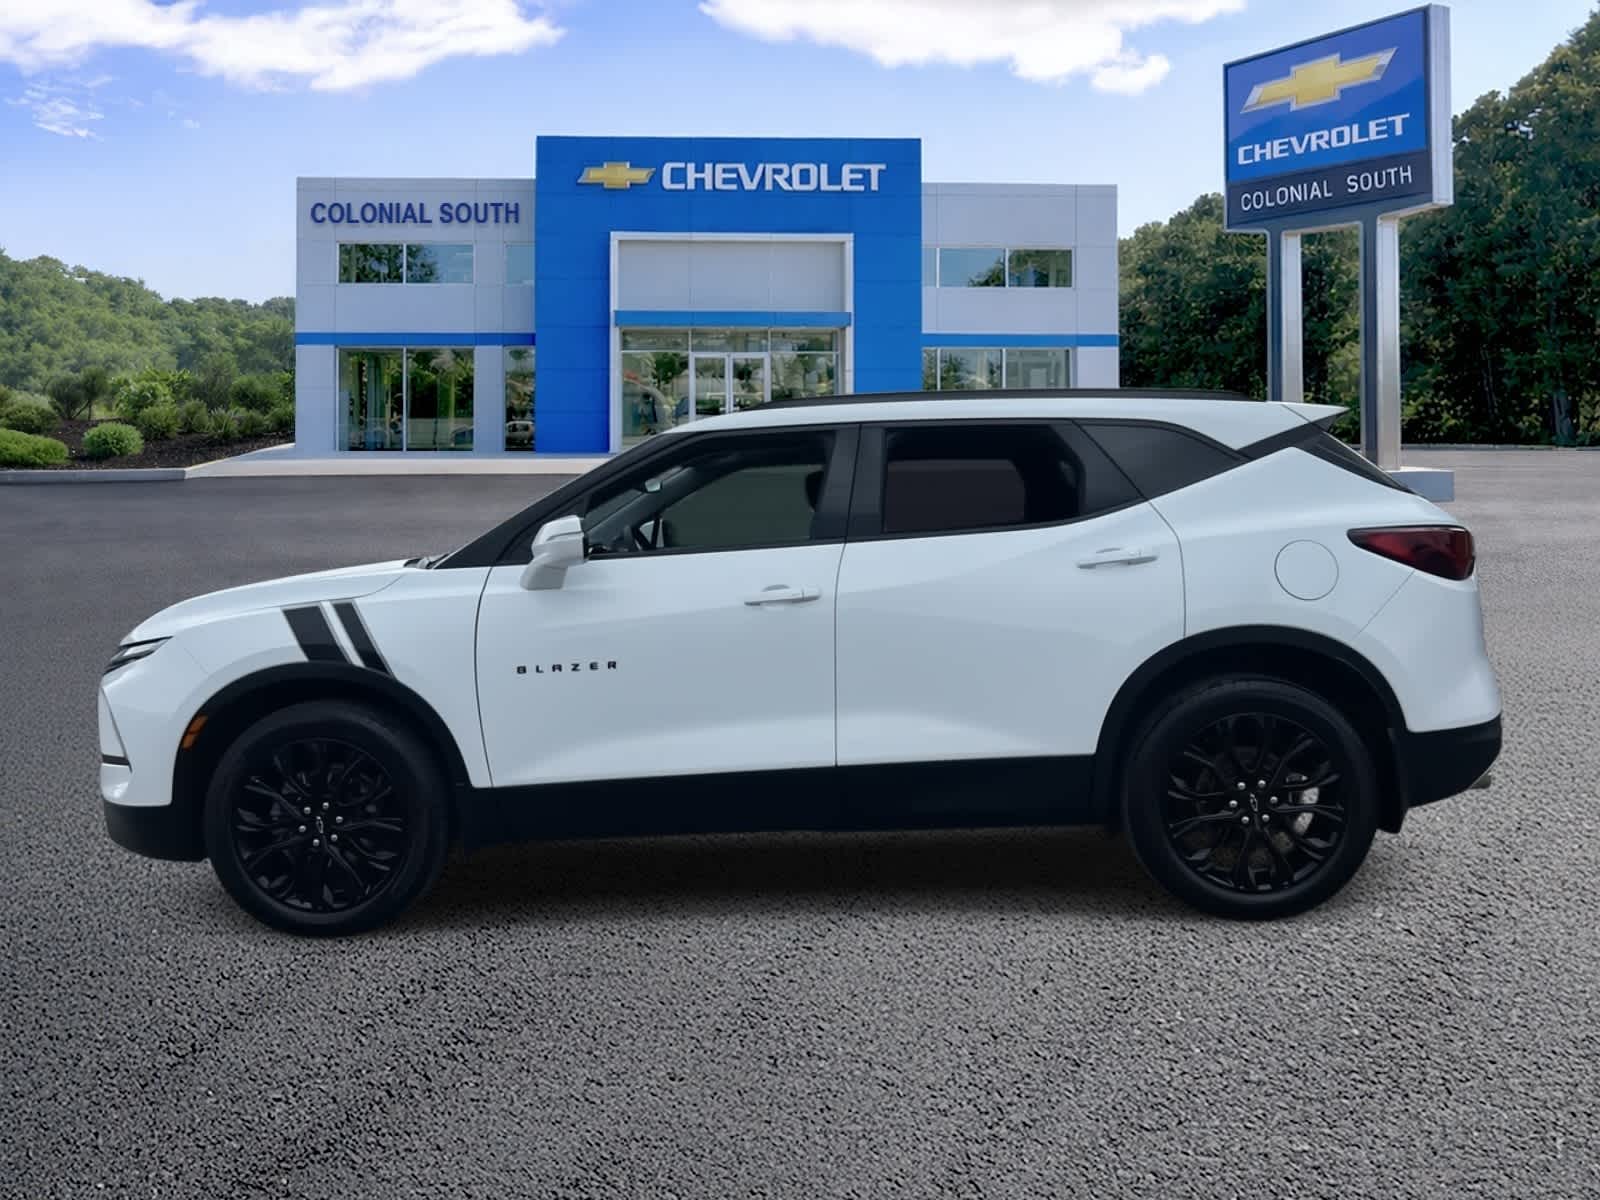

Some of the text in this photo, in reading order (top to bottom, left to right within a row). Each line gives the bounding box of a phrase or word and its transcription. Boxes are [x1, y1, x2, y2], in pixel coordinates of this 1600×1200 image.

[1238, 113, 1410, 165] CHEVROLET
[661, 162, 886, 192] CHEVROLET
[1241, 165, 1412, 211] COLONIAL SOUTH
[310, 202, 521, 225] COLONIAL SOUTH
[516, 661, 617, 674] BLAZER
